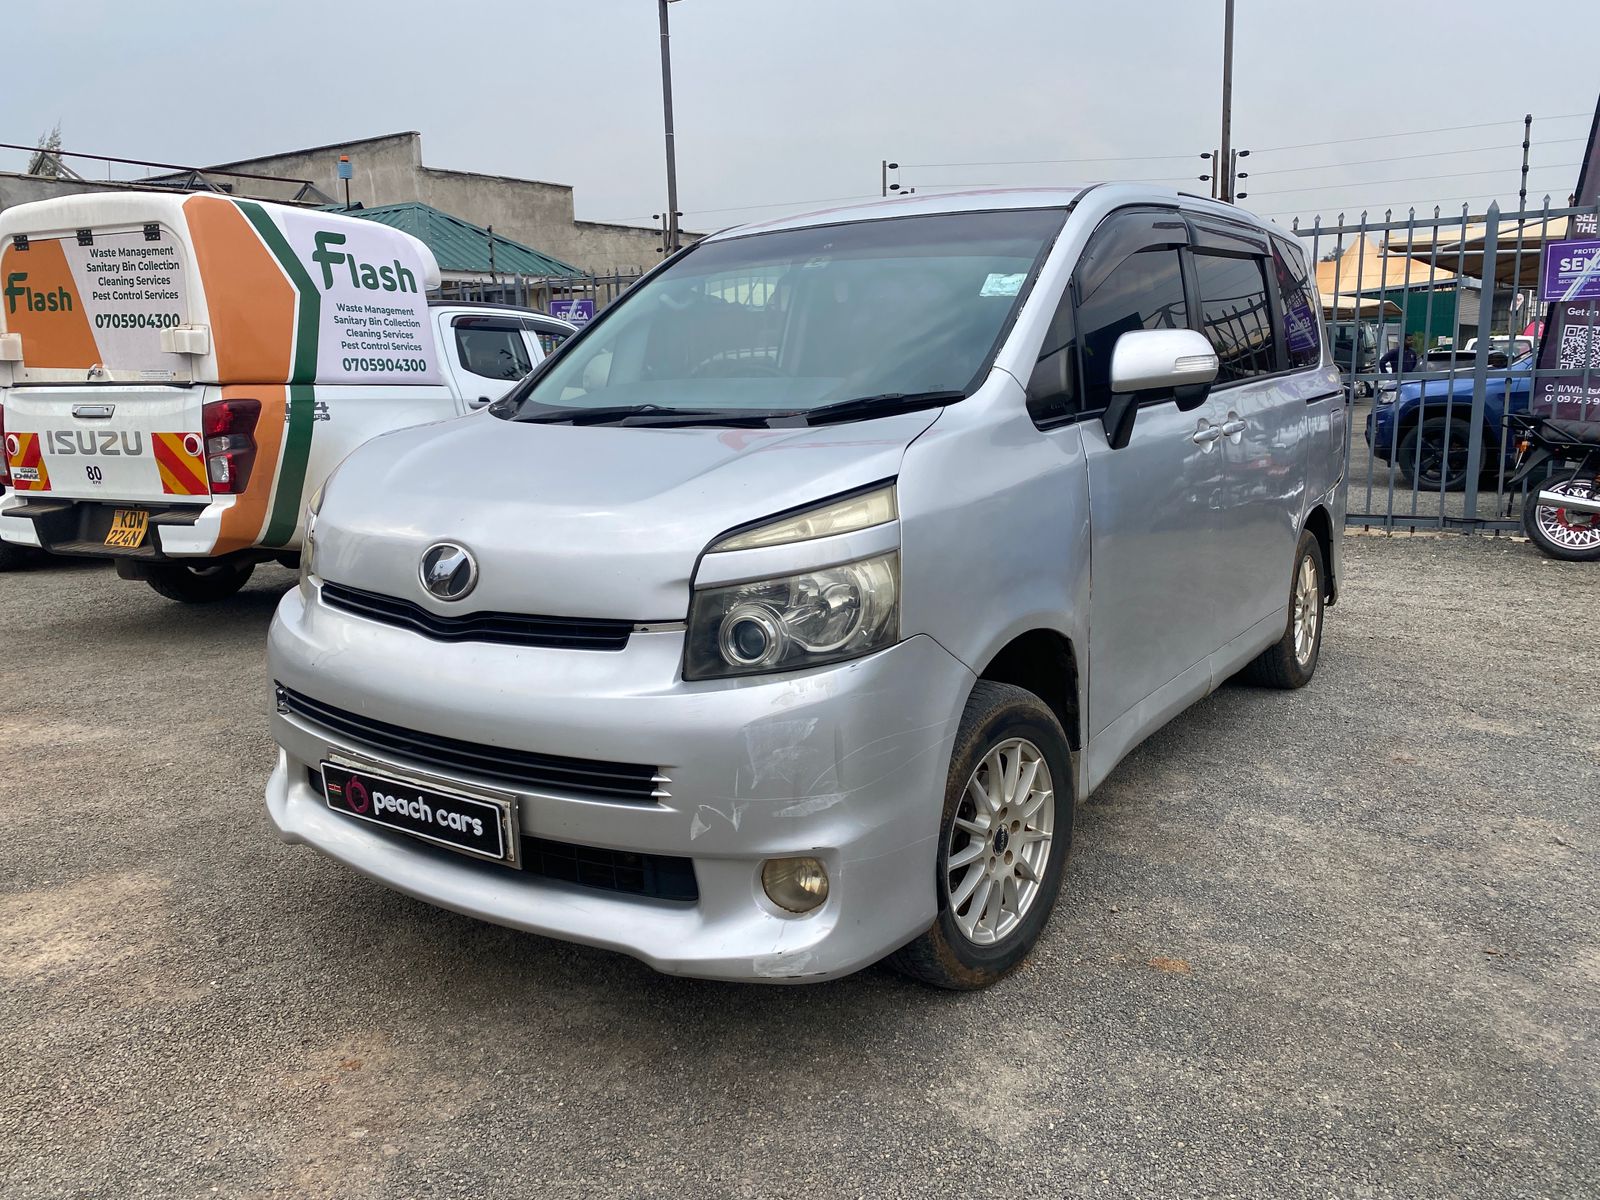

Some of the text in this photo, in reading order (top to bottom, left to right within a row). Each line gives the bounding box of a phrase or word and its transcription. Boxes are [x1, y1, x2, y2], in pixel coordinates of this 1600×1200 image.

[1577, 223, 1598, 233] THE
[90, 246, 174, 259] Waste Management
[86, 260, 180, 274] Sanitary Bin Collection
[312, 231, 418, 293] Flash
[98, 276, 171, 288] Cleaning Services
[4, 272, 73, 314] Flash
[92, 289, 179, 301] Pest Control Services
[336, 303, 414, 316] Waste Management
[1567, 307, 1585, 316] Get
[95, 313, 181, 329] 0705904300
[333, 315, 421, 328] Sanitary Bin Collection
[346, 328, 414, 339] Cleaning Services
[341, 341, 422, 351] Pest Control Services
[342, 357, 427, 372] 0705904300
[1545, 394, 1571, 402] 009
[46, 430, 143, 456] ISUZU
[86, 465, 102, 480] 80
[120, 511, 146, 529] KDW
[105, 529, 141, 546] 224N
[372, 791, 484, 837] peach cars
